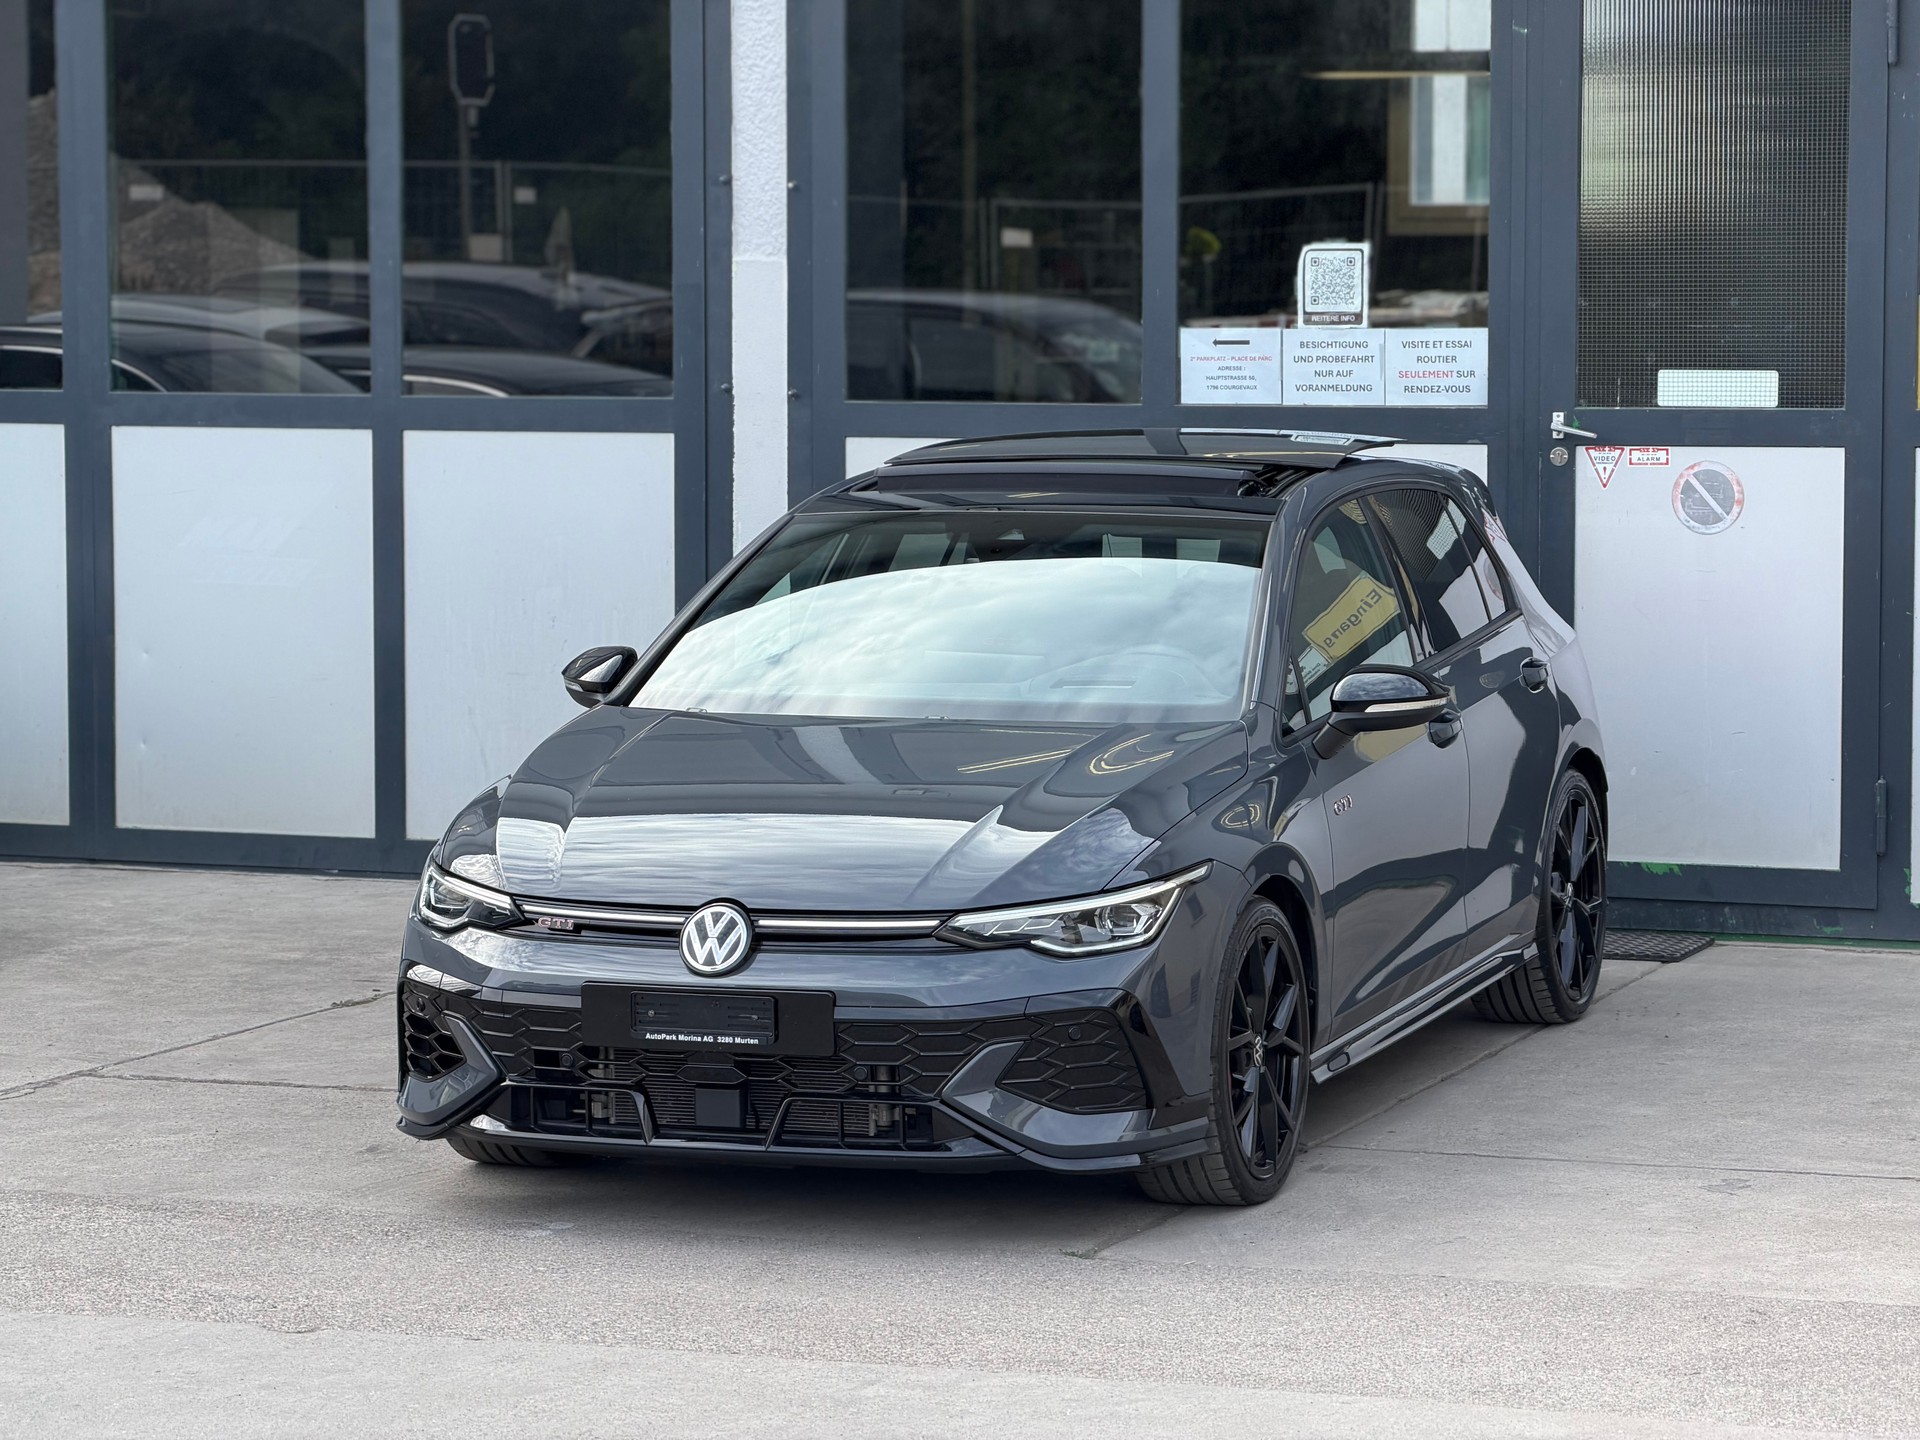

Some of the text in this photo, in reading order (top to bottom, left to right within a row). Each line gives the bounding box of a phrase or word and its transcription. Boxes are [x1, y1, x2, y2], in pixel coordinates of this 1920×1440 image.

[1299, 340, 1369, 349] BESICHTIGUNG
[1401, 340, 1472, 349] VISITE ET ESSAI
[1293, 355, 1375, 363] UND PROBEFAHRT
[1416, 355, 1457, 364] ROUTIER
[1314, 369, 1354, 378] NUR AUF
[1398, 370, 1476, 379] SEULEMENT SUR
[1295, 384, 1373, 392] VORANMELDUNG
[1404, 385, 1471, 393] RENDEZ-VOUS
[538, 917, 575, 930] GTI
[645, 1032, 677, 1041] AutoPark
[678, 1034, 702, 1042] Morina
[702, 1035, 714, 1043] AG
[734, 1037, 759, 1045] Murten
